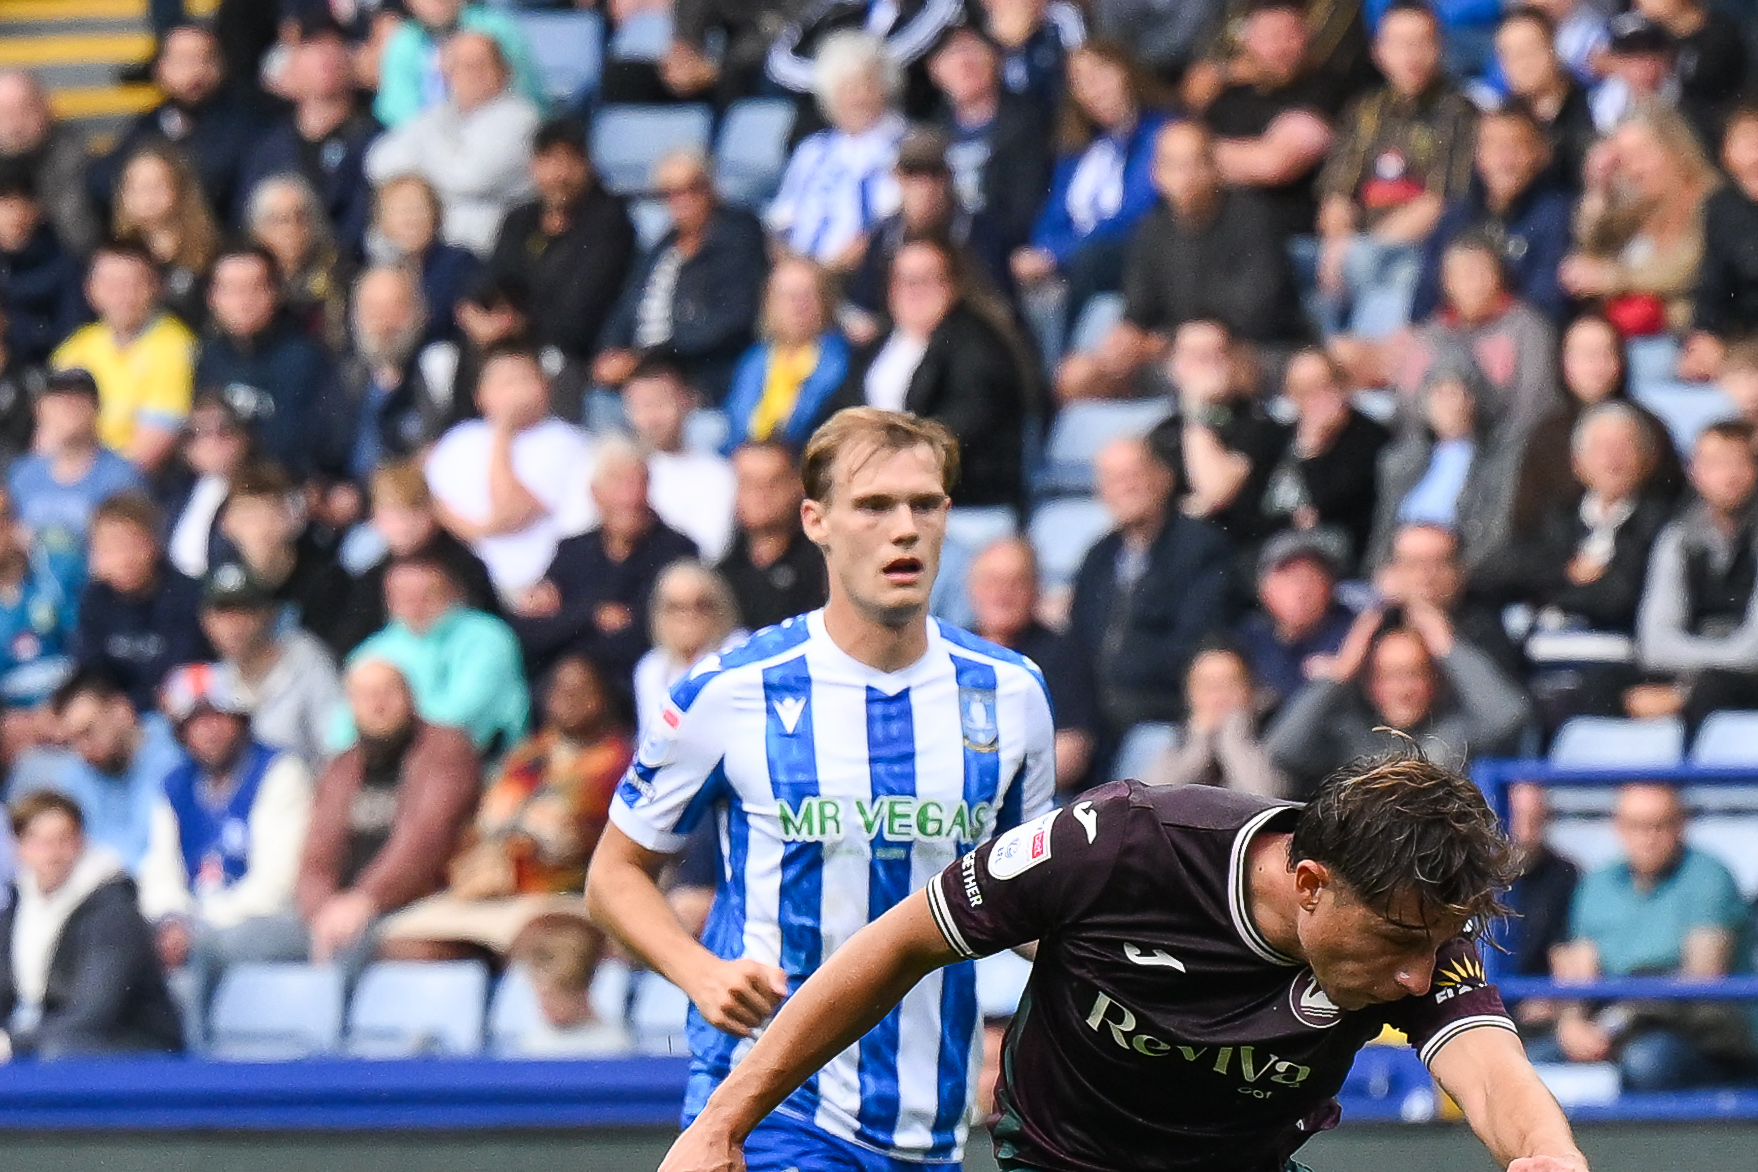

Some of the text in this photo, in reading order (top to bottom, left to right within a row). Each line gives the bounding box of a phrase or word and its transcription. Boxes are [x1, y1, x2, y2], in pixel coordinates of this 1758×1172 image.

[778, 799, 990, 841] MR VEGAS
[962, 850, 983, 908] GETHER
